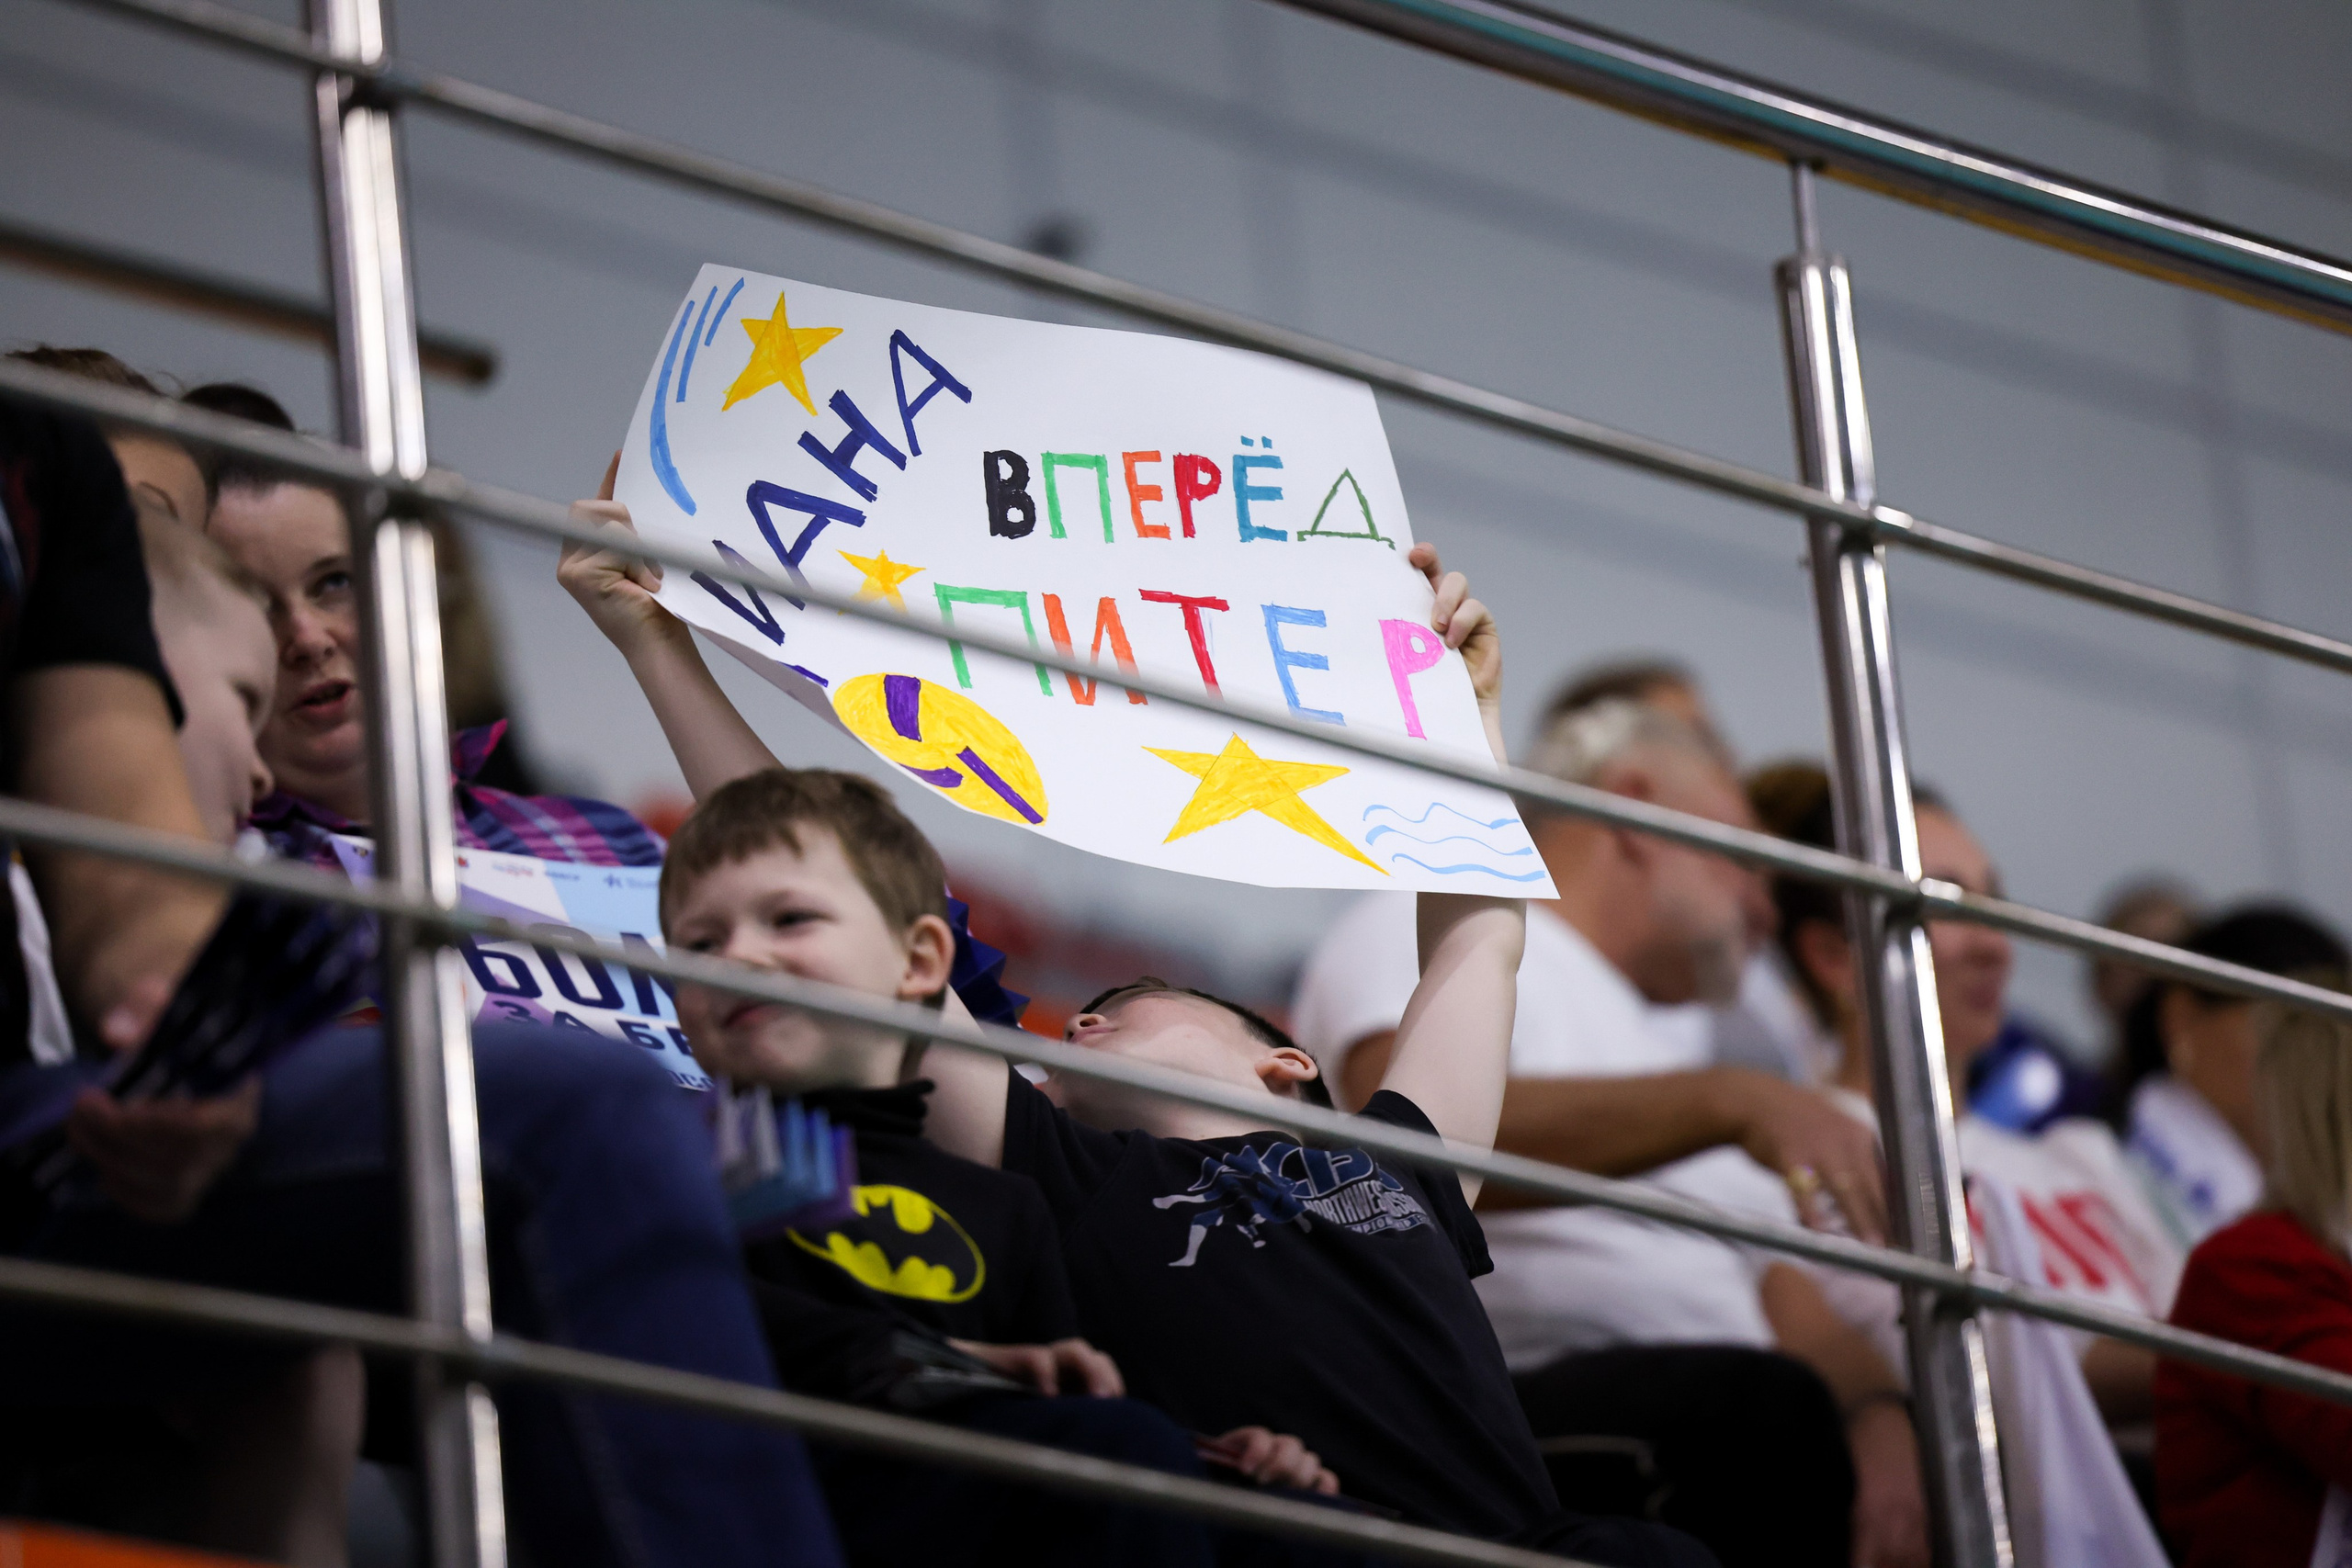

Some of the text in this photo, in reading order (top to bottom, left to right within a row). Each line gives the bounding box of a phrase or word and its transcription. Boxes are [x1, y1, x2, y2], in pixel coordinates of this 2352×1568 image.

[675, 329, 972, 680] ИАНА
[982, 435, 1396, 550] ВПЕРЁД
[933, 581, 1446, 741] ПИТЕР
[457, 919, 678, 1017] БОЛ
